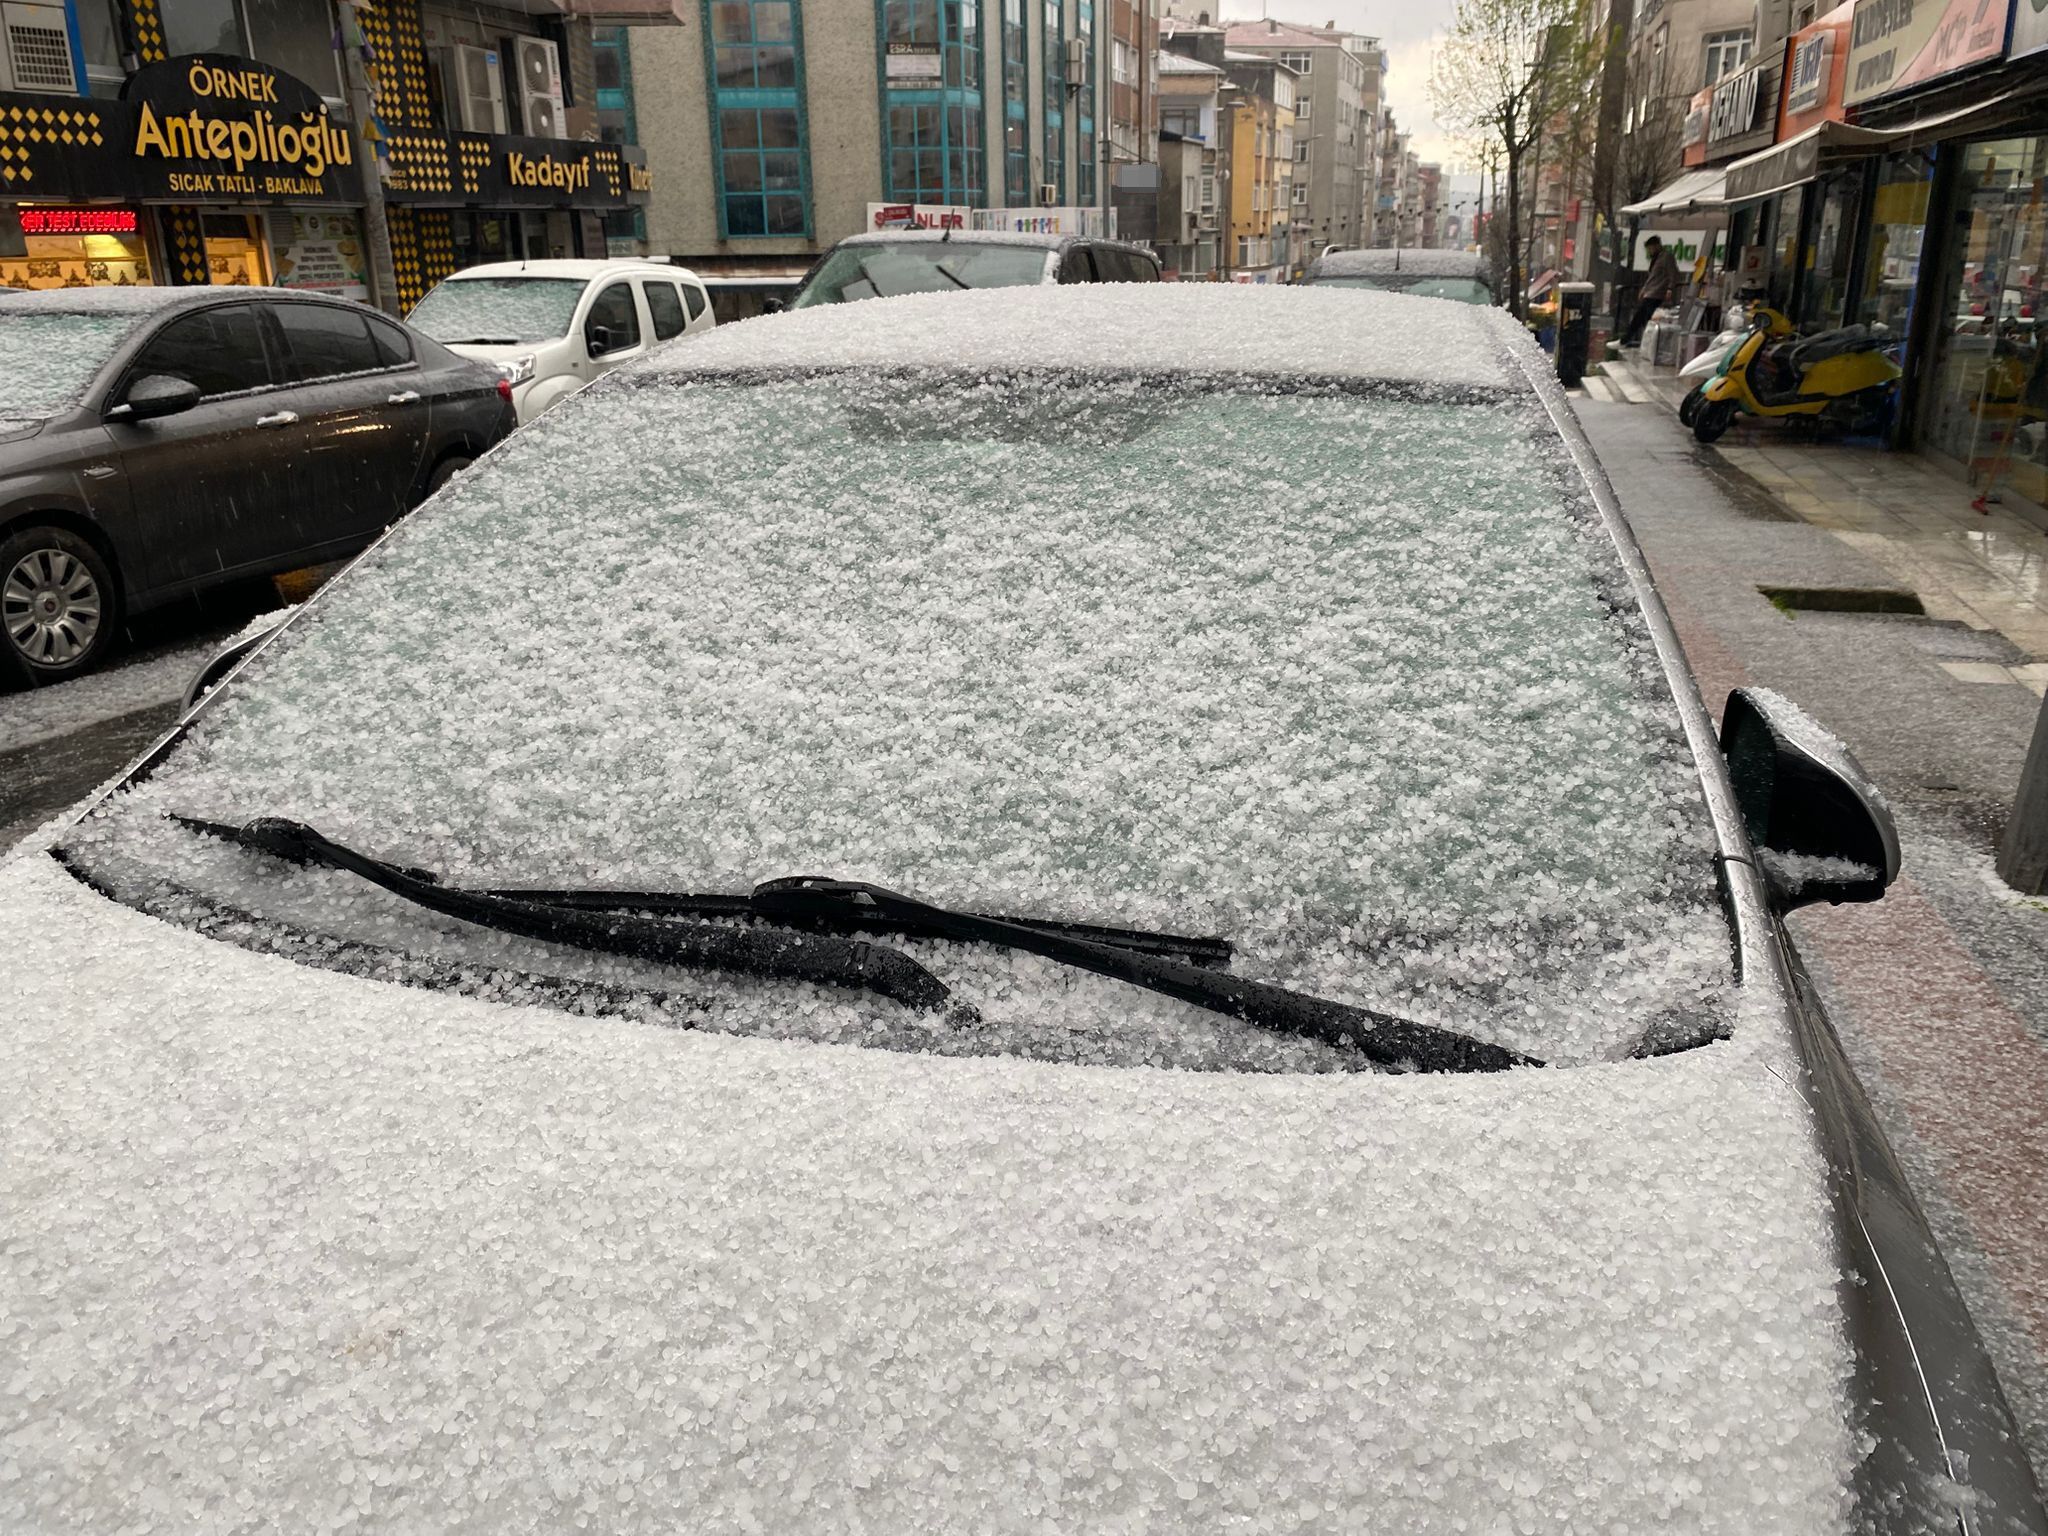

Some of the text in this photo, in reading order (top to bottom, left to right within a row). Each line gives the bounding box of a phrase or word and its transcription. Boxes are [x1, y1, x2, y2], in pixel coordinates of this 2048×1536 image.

[189, 59, 279, 103] ÖRNEK
[135, 100, 353, 177] Anteplioğlu
[169, 173, 215, 192] SICAK
[217, 175, 255, 193] TATLI
[265, 177, 324, 195] BAKLAVA
[508, 152, 590, 194] Kadayıf
[46, 214, 77, 228] TEST
